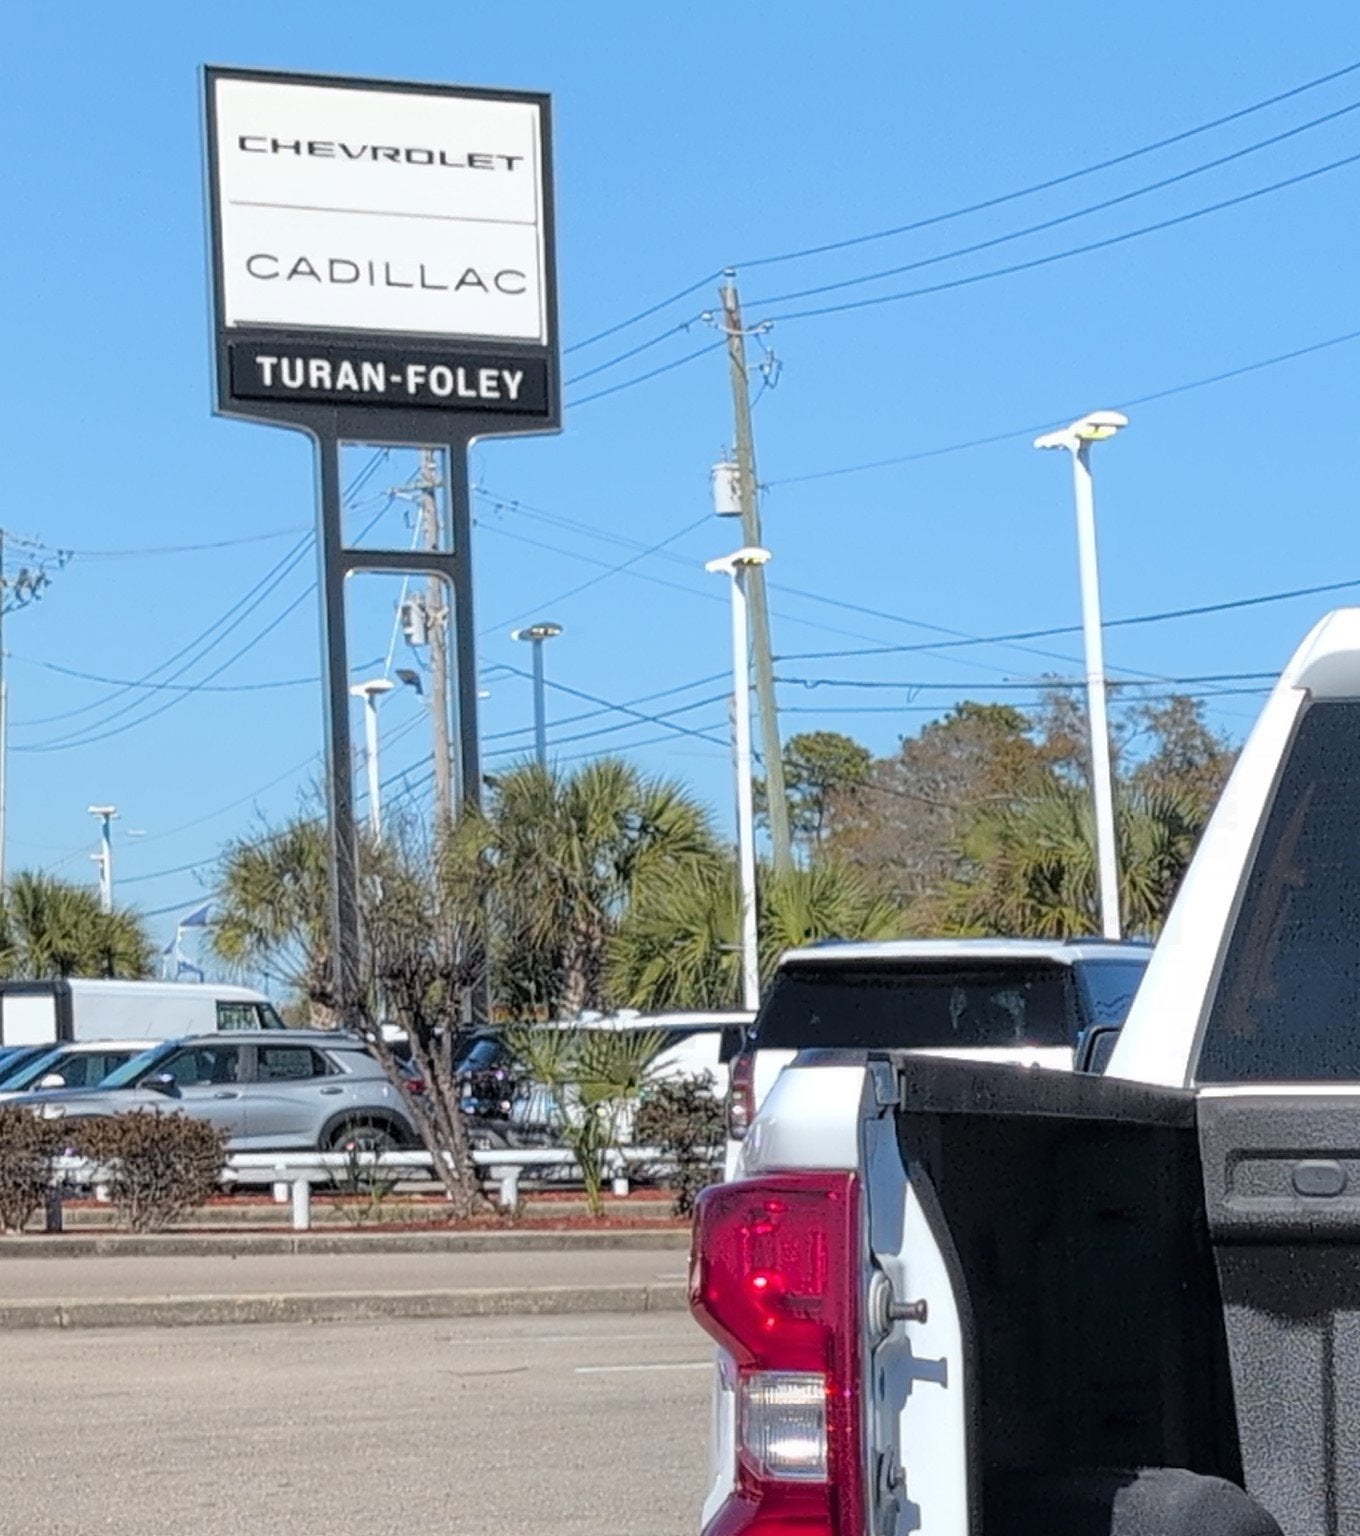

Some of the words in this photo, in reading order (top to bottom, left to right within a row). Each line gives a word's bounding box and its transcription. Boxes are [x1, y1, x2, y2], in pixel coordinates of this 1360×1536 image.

[238, 135, 524, 171] CHEVROLET
[246, 254, 527, 294] CADILLAC
[256, 356, 524, 400] TURAN-FOLEY
